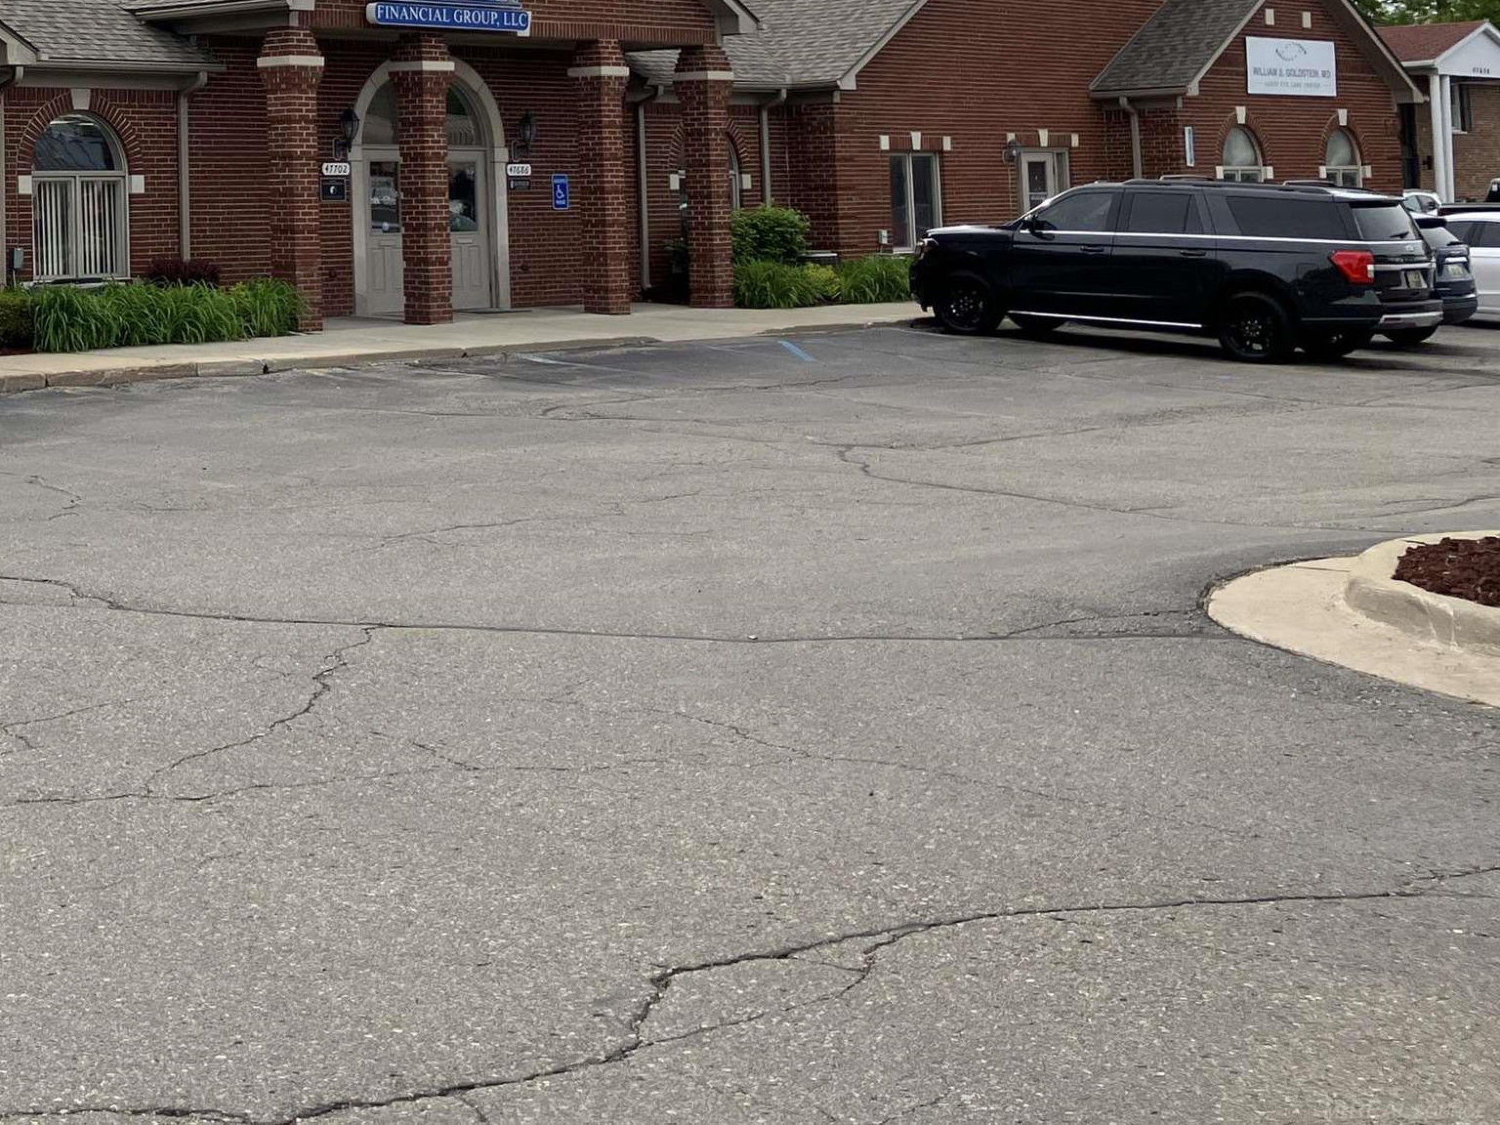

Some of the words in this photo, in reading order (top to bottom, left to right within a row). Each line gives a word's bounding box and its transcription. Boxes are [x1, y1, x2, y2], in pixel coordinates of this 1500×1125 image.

[377, 5, 450, 23] FINANCIAL
[453, 10, 500, 27] GROUP,
[503, 12, 528, 27] LLC
[325, 164, 348, 174] 47702
